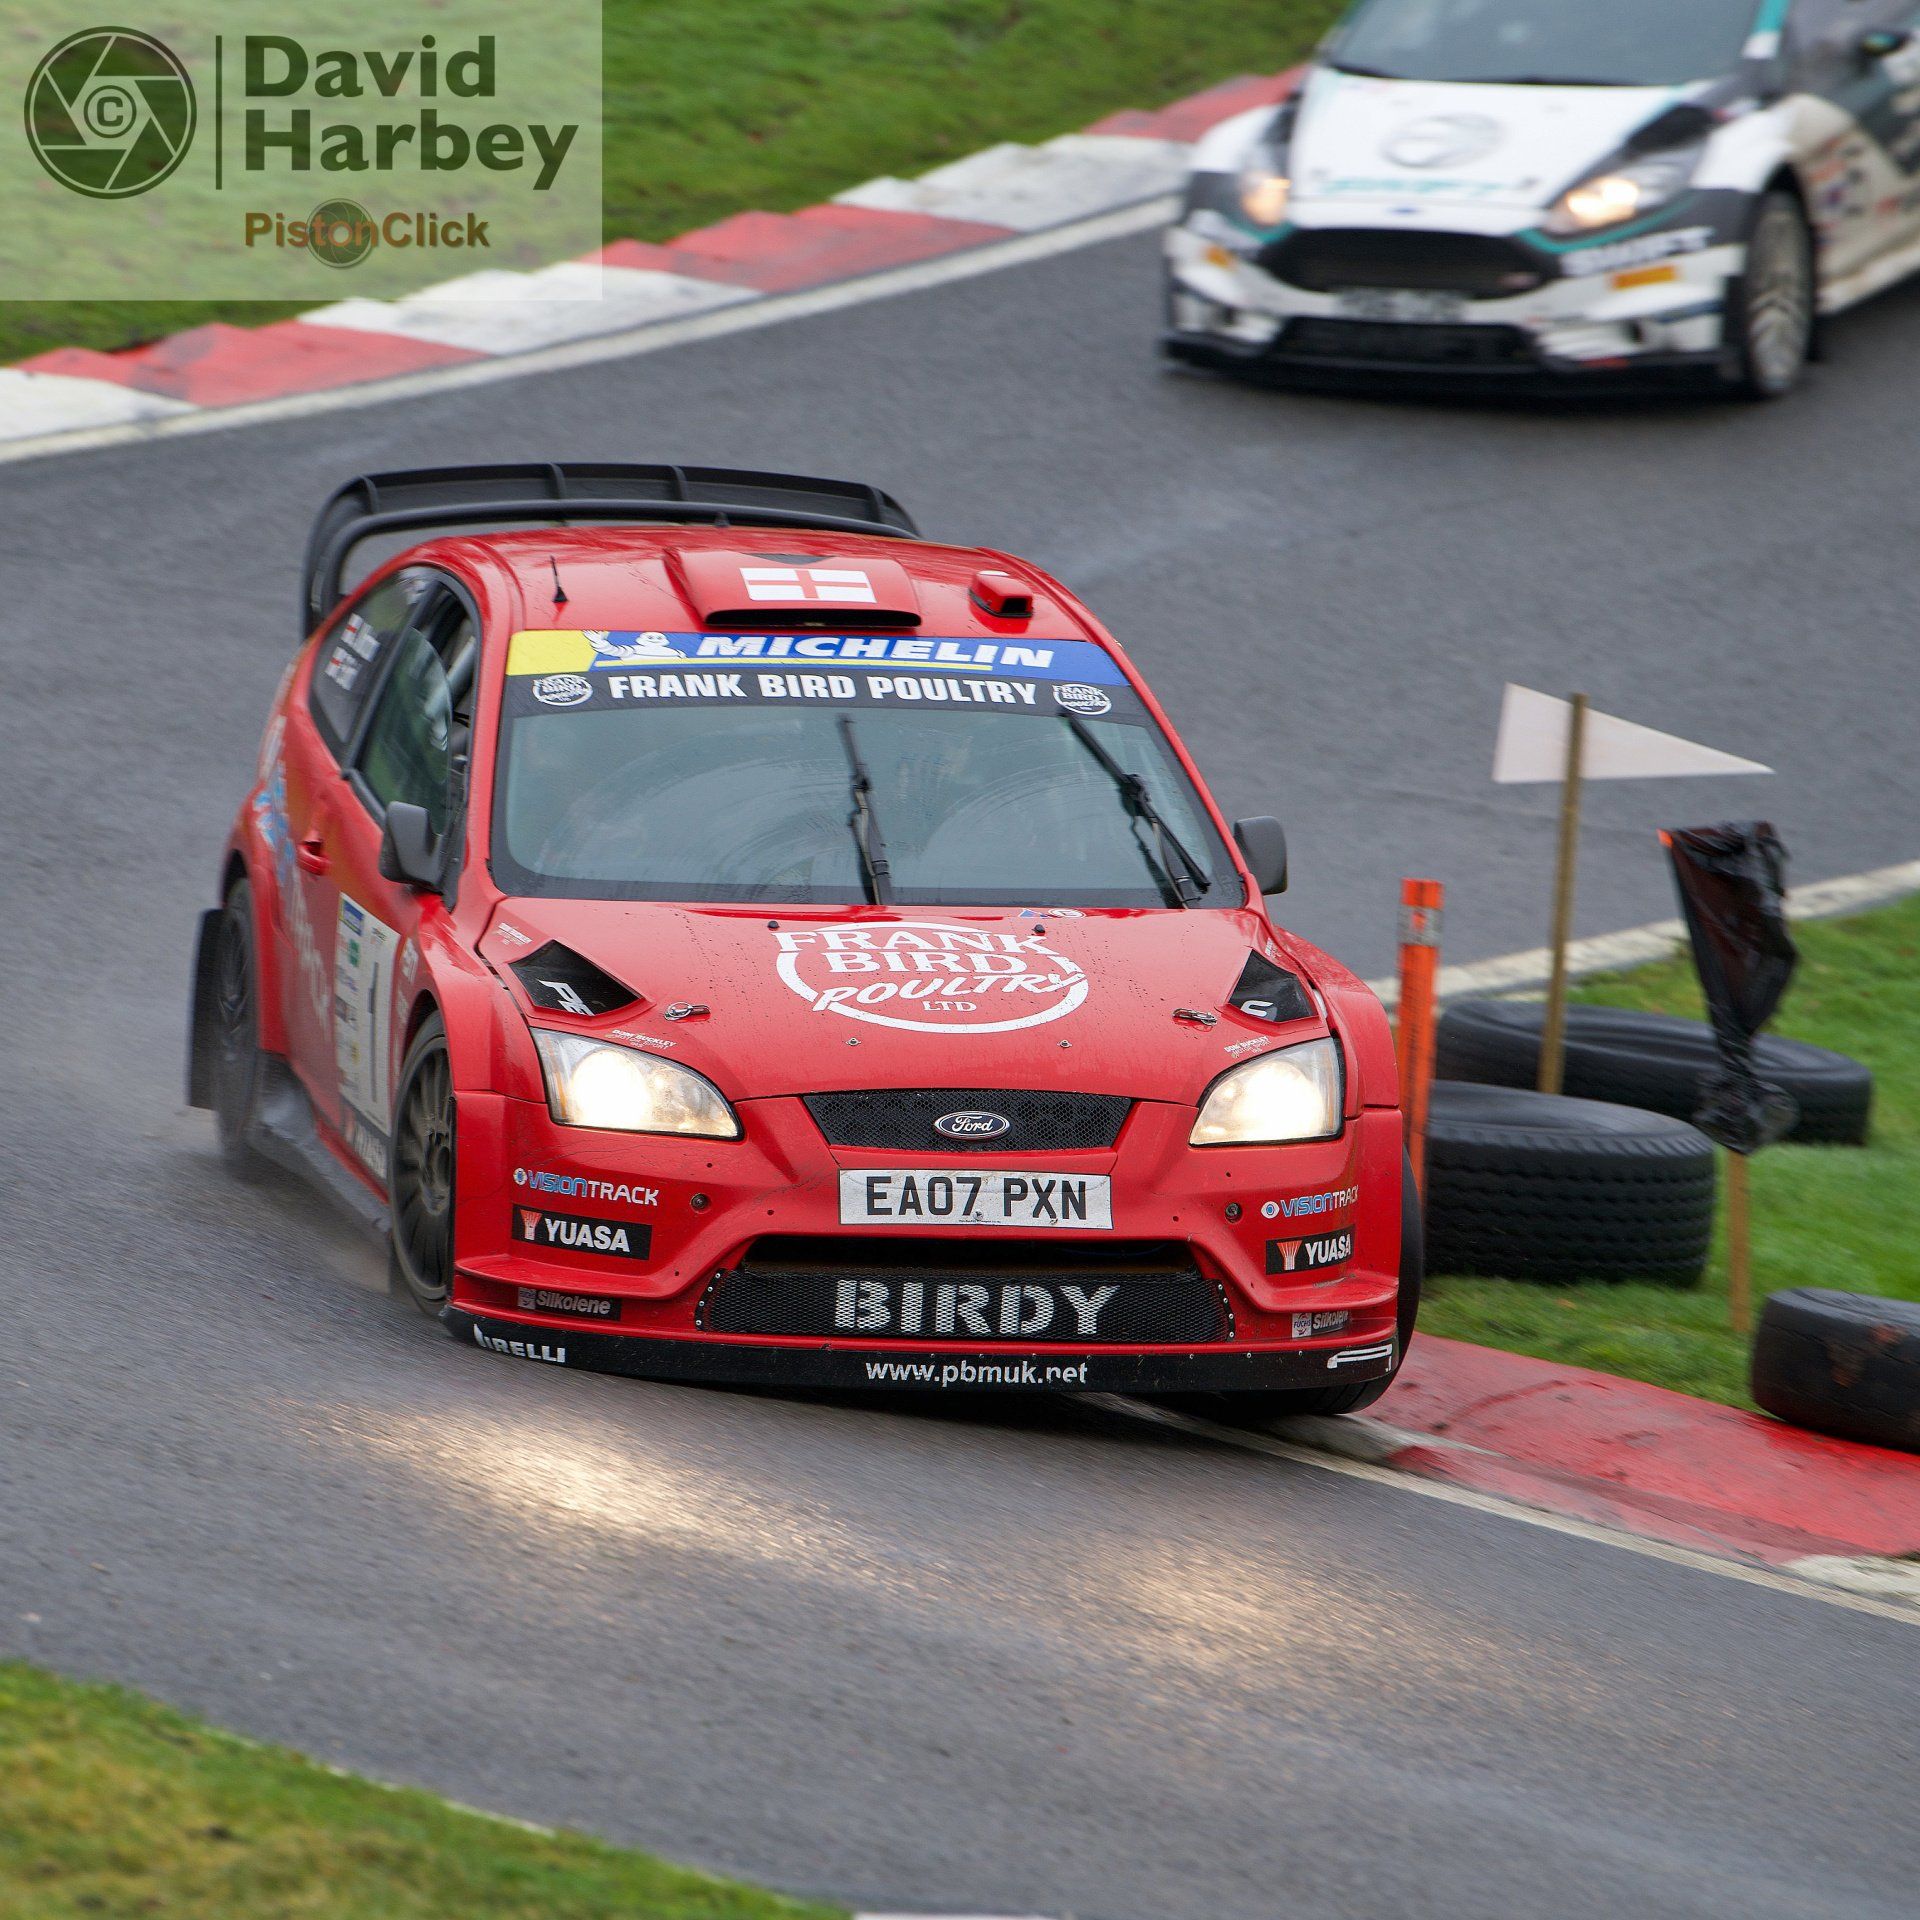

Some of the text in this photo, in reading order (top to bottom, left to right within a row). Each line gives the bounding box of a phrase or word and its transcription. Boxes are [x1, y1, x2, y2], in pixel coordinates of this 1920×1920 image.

[696, 636, 1056, 668] MICHELIN
[608, 674, 747, 700] FRANK
[757, 674, 857, 700] BIRD
[867, 676, 1037, 705] POULTRY
[771, 930, 1060, 955] FRANK
[821, 951, 1028, 973] BIRD
[812, 973, 1087, 1011] POULTRY
[922, 1000, 977, 1012] LTD
[951, 1115, 994, 1132] Ford
[866, 1176, 1087, 1220] EA07 PXN
[545, 1218, 631, 1253] YUASA
[1305, 1234, 1351, 1265] YUASA
[537, 1290, 611, 1315] Silkolene
[835, 1279, 1120, 1334] BIRDY
[866, 1361, 1088, 1387] www.pbmuk.net
